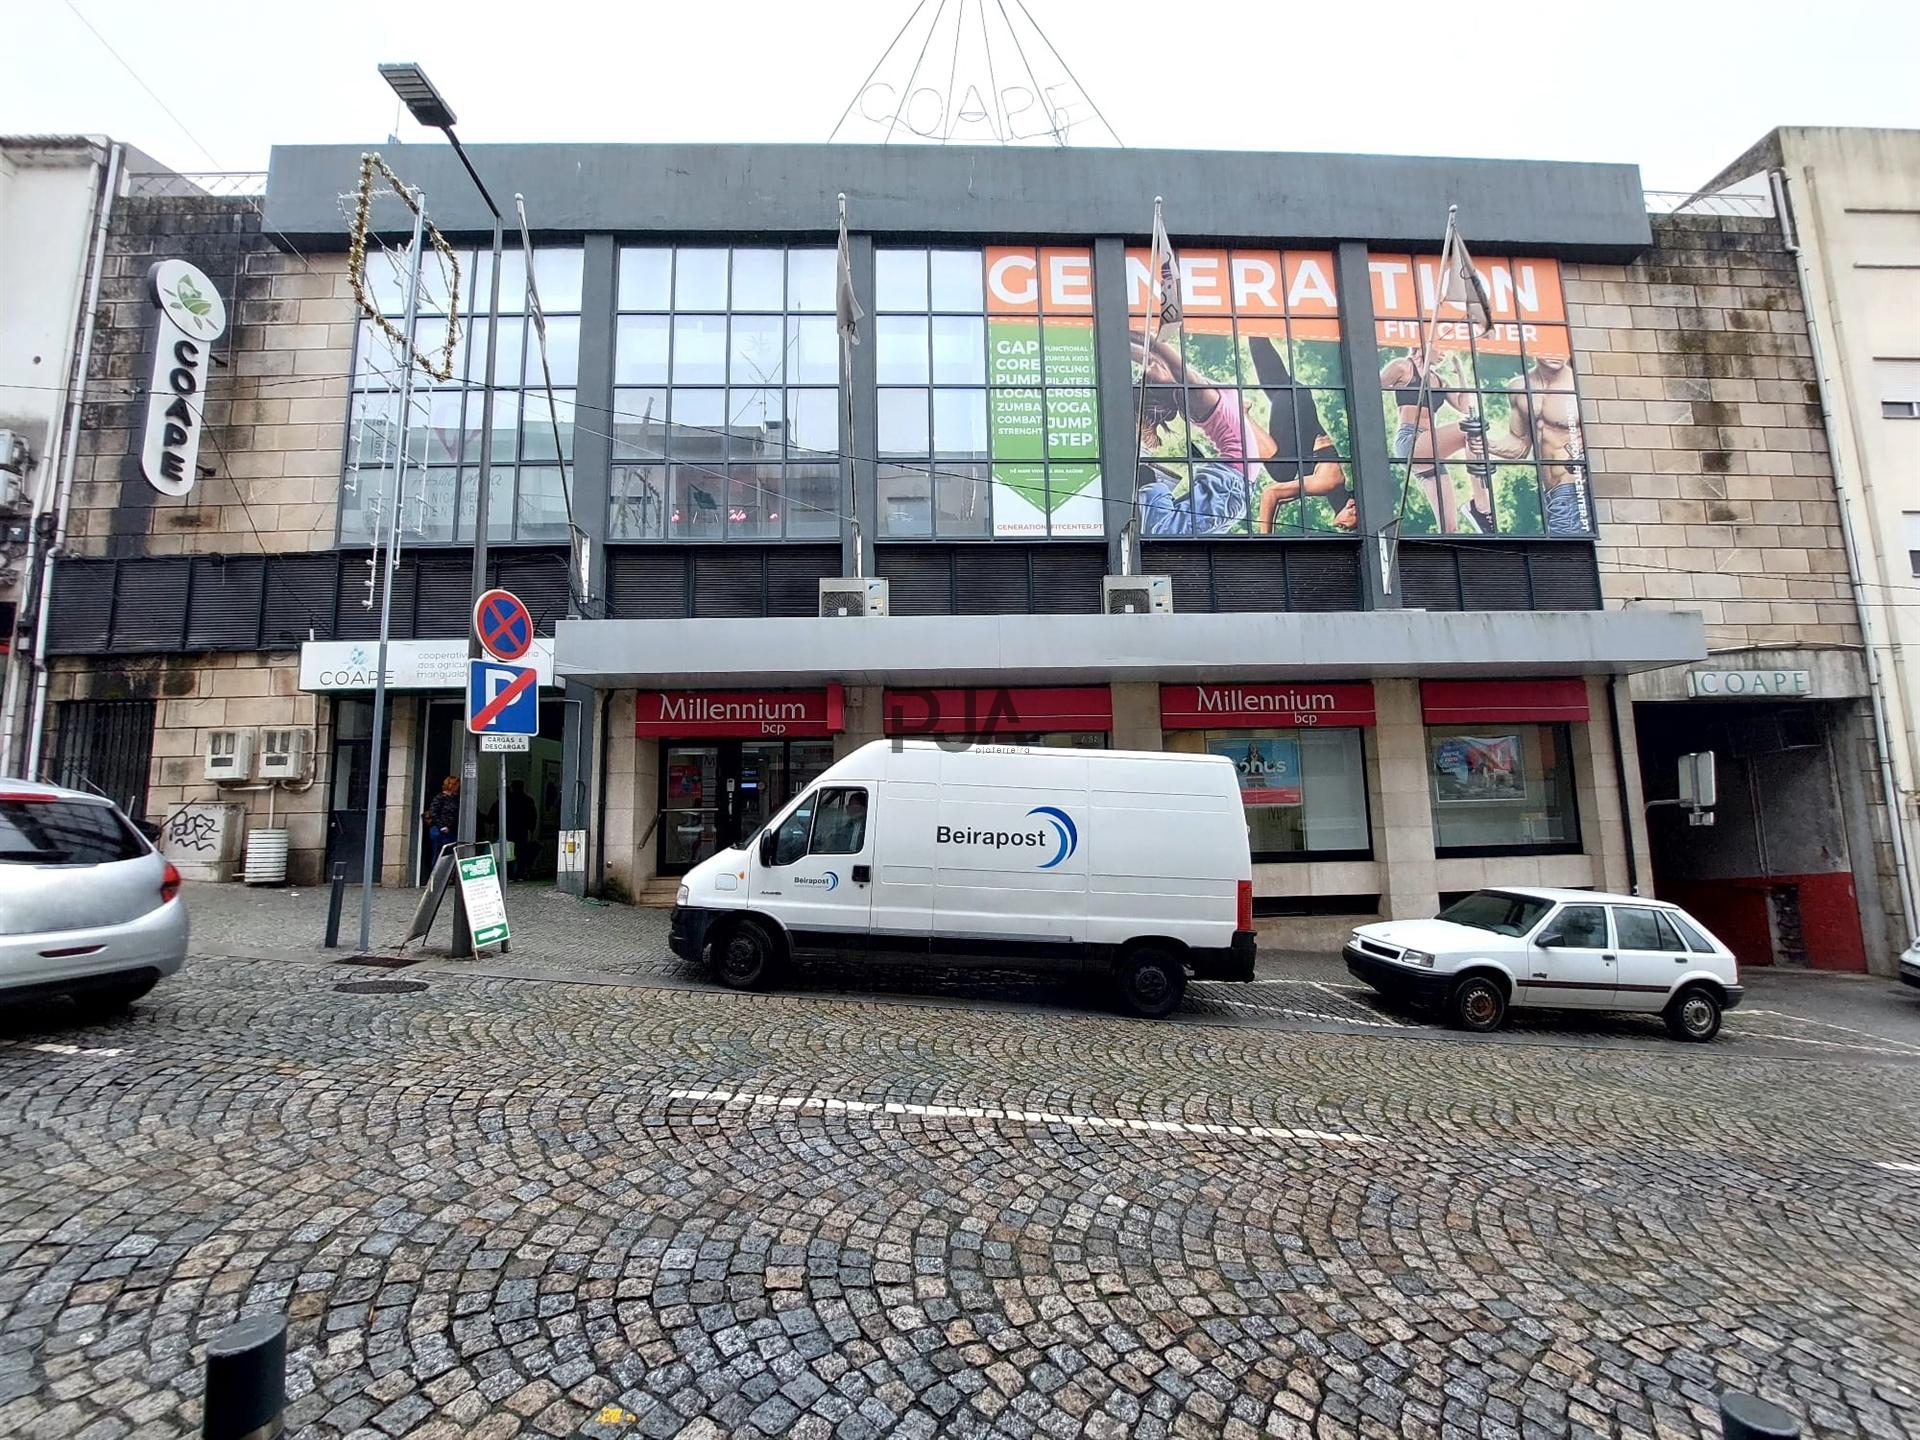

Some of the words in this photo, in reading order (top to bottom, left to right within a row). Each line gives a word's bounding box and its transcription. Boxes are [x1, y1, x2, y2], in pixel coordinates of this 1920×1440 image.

[1384, 321, 1419, 338] FIT
[996, 340, 1039, 355] GAP
[995, 358, 1041, 370] CORE
[1045, 365, 1090, 374] CYCLING
[996, 374, 1042, 385] PUMP
[1045, 377, 1090, 385] PILATES
[996, 388, 1042, 398] LOCAL
[1046, 388, 1091, 398] CROSS
[160, 340, 200, 482] COAPE
[996, 402, 1042, 412] ZUMBA
[1047, 402, 1091, 413] YOGA
[997, 415, 1043, 424] COMBAT
[1047, 416, 1092, 429] JUMP
[998, 427, 1043, 435] STRENGHT
[1048, 432, 1093, 446] STEP
[418, 650, 468, 661] cooperativ
[320, 671, 395, 686] COAPE
[1701, 673, 1806, 693] COAPE
[1197, 686, 1335, 712] Millennium
[659, 693, 806, 720] Millennium
[1294, 712, 1318, 726] bcp
[761, 721, 786, 735] bcp
[936, 826, 1046, 849] Beirapost
[794, 876, 829, 885] Beirapost
